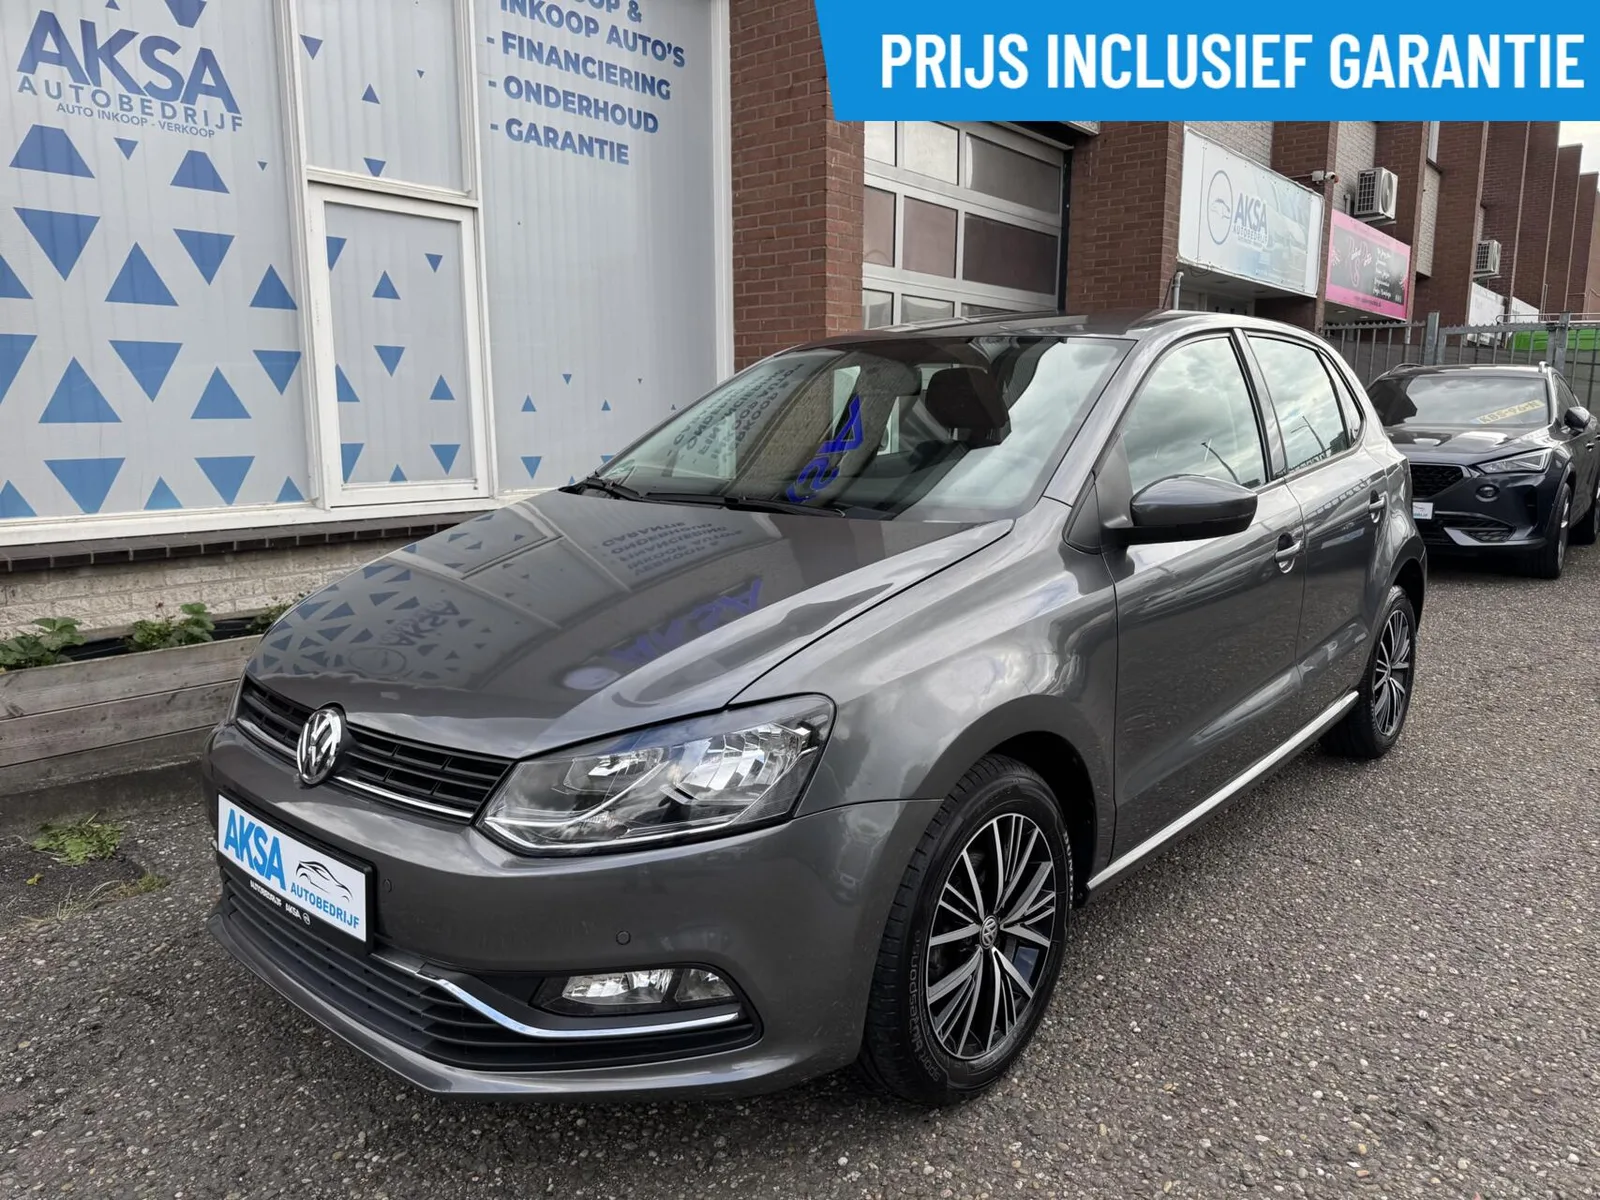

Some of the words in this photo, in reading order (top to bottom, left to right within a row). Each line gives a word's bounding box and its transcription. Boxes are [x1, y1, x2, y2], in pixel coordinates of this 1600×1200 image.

[17, 10, 241, 114] AKSA
[502, 31, 671, 100] FINANCIERING
[606, 24, 686, 68] AUTO'S
[18, 75, 243, 132] AUTOBEDRIJF
[56, 102, 94, 118] AUTO
[98, 111, 148, 127] INKOOP
[158, 120, 215, 139] VERKOOP
[503, 75, 659, 134] ONDERHOUD
[505, 118, 630, 165] GARANTIE
[1234, 193, 1267, 237] AKSA
[224, 808, 287, 891] AKSA
[290, 882, 360, 929] AUTOBEDRIJF
